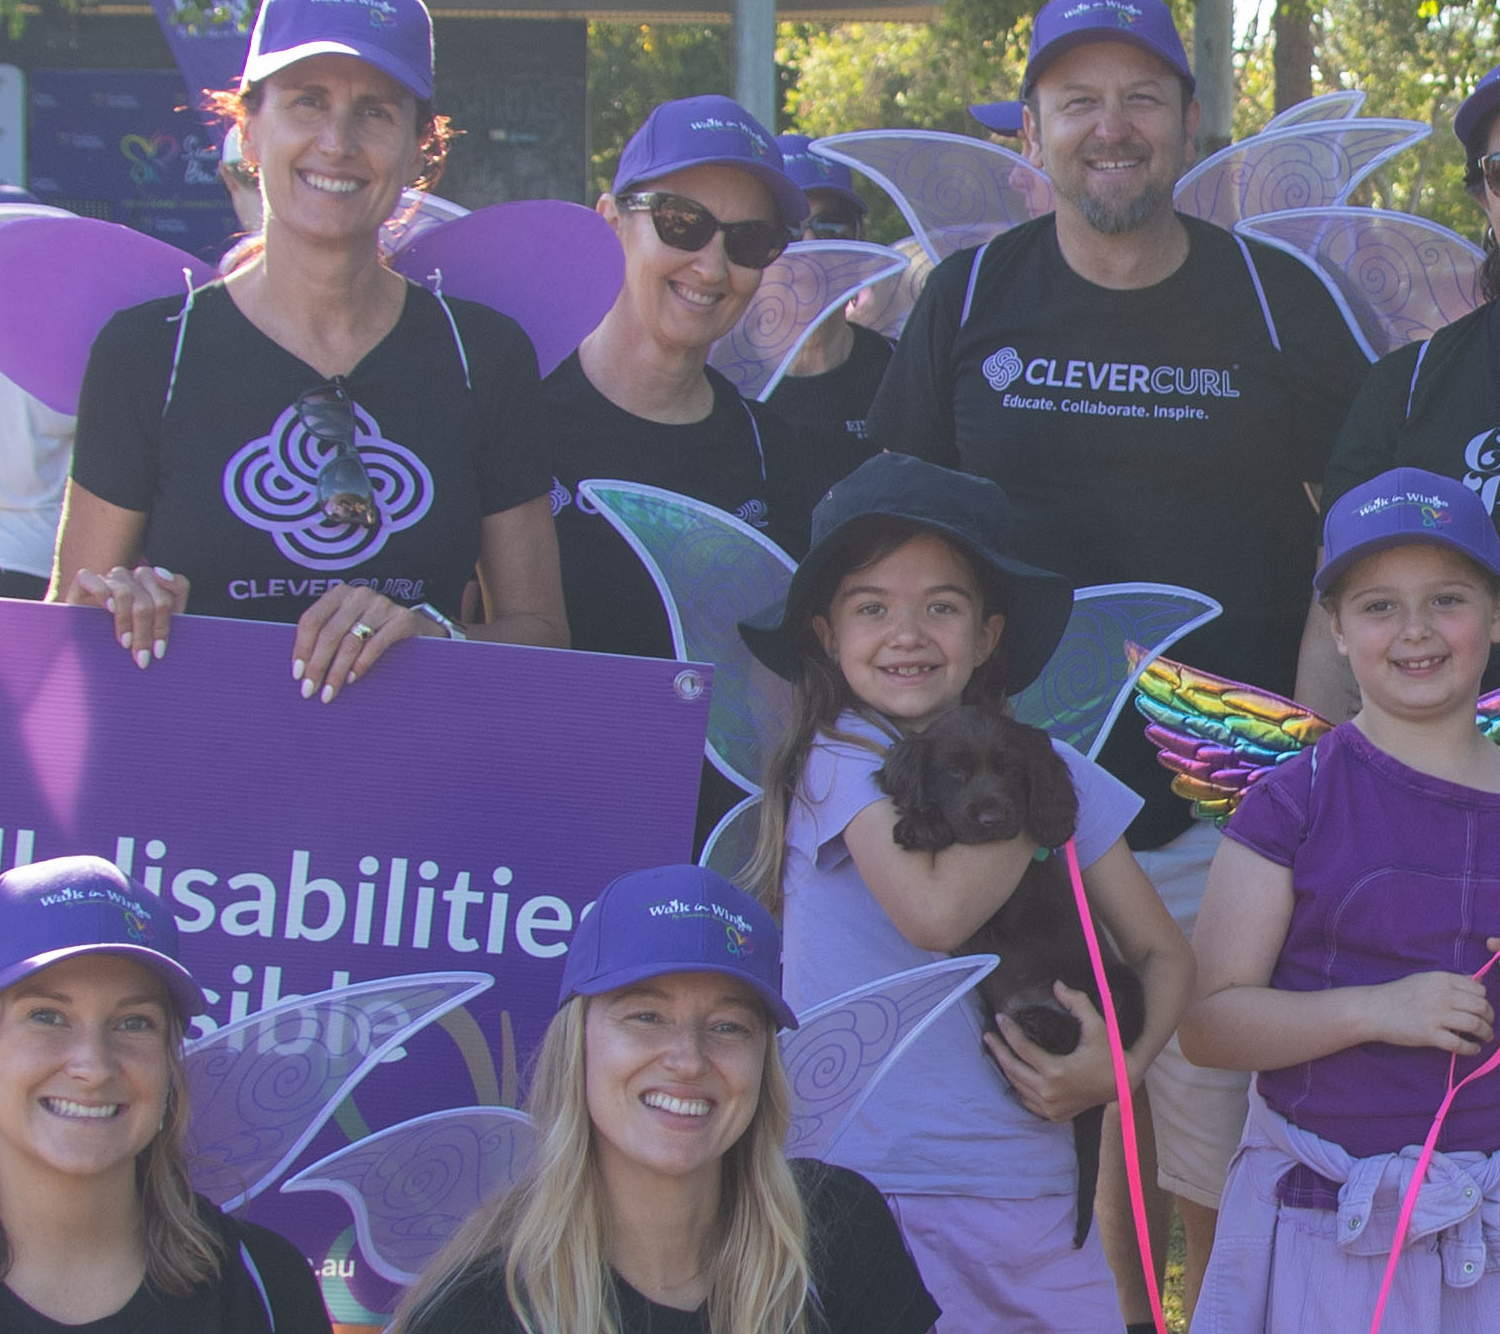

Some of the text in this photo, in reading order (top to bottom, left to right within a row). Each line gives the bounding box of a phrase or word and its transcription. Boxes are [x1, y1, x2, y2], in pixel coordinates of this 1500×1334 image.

[1024, 358, 1241, 399] CLEVERCURL
[1002, 393, 1210, 423] Educate. Collaborate. Inspire.
[1359, 497, 1389, 517] Walk
[1406, 492, 1449, 510] Wings
[40, 886, 85, 907] Walk
[648, 898, 690, 917] Walk
[711, 902, 753, 933] Wings
